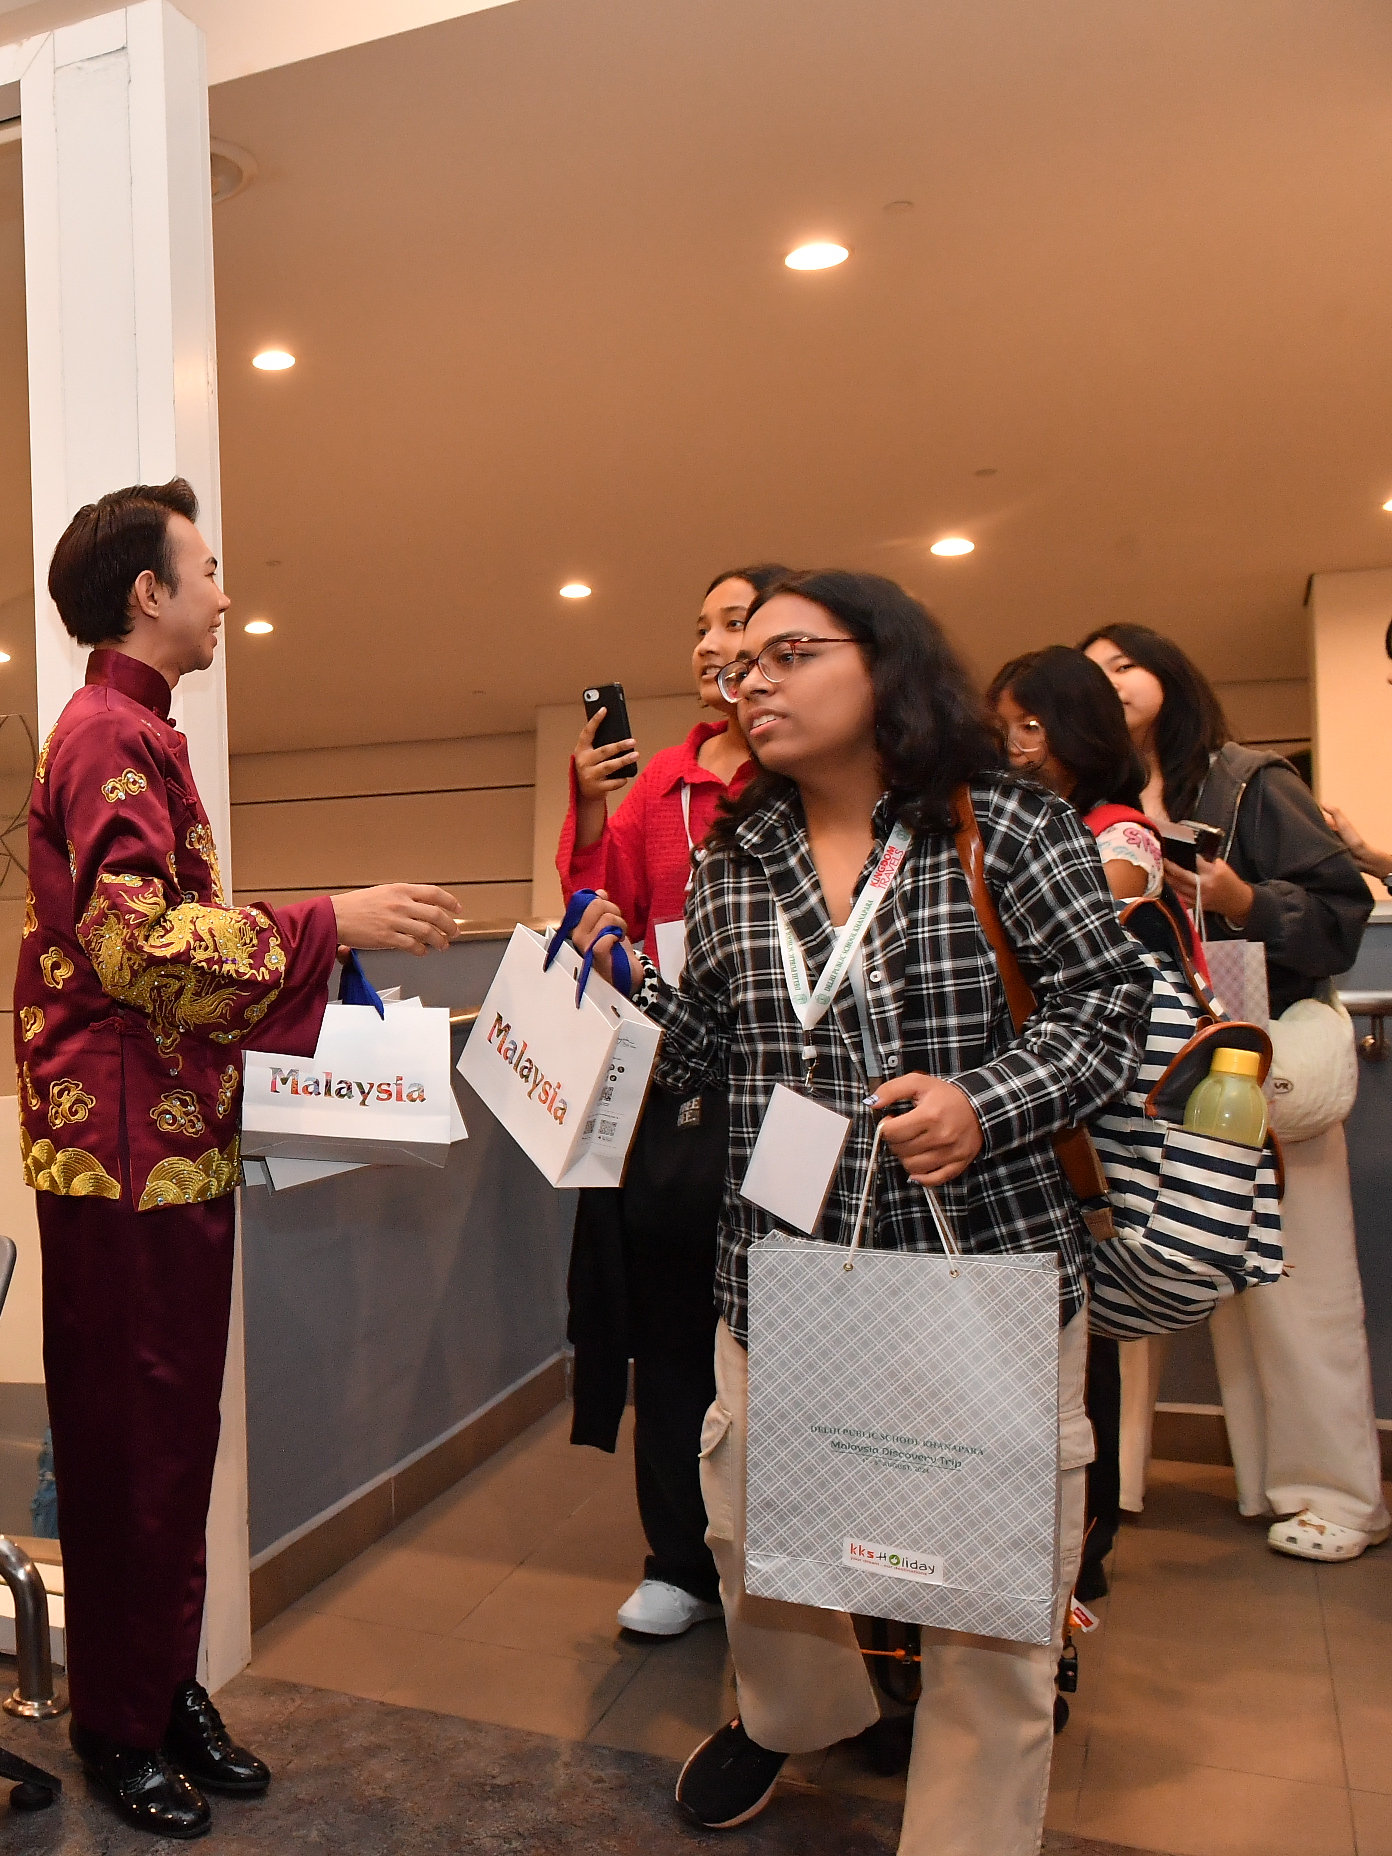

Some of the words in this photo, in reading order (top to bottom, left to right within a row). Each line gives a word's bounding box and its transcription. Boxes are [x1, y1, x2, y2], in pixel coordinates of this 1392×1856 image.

[869, 845, 897, 888] KINGDOM
[877, 849, 904, 890] TRAVELS
[269, 1067, 427, 1107] Malaysia
[487, 1011, 568, 1125] Malaysia
[810, 1425, 841, 1435] DELHI
[842, 1429, 878, 1440] PUBLIC
[879, 1434, 919, 1446] SCHOOL
[922, 1440, 984, 1456] KHANAPARA
[830, 1440, 880, 1455] Malaysia
[881, 1447, 937, 1465] Discovery
[939, 1456, 962, 1469] Trip
